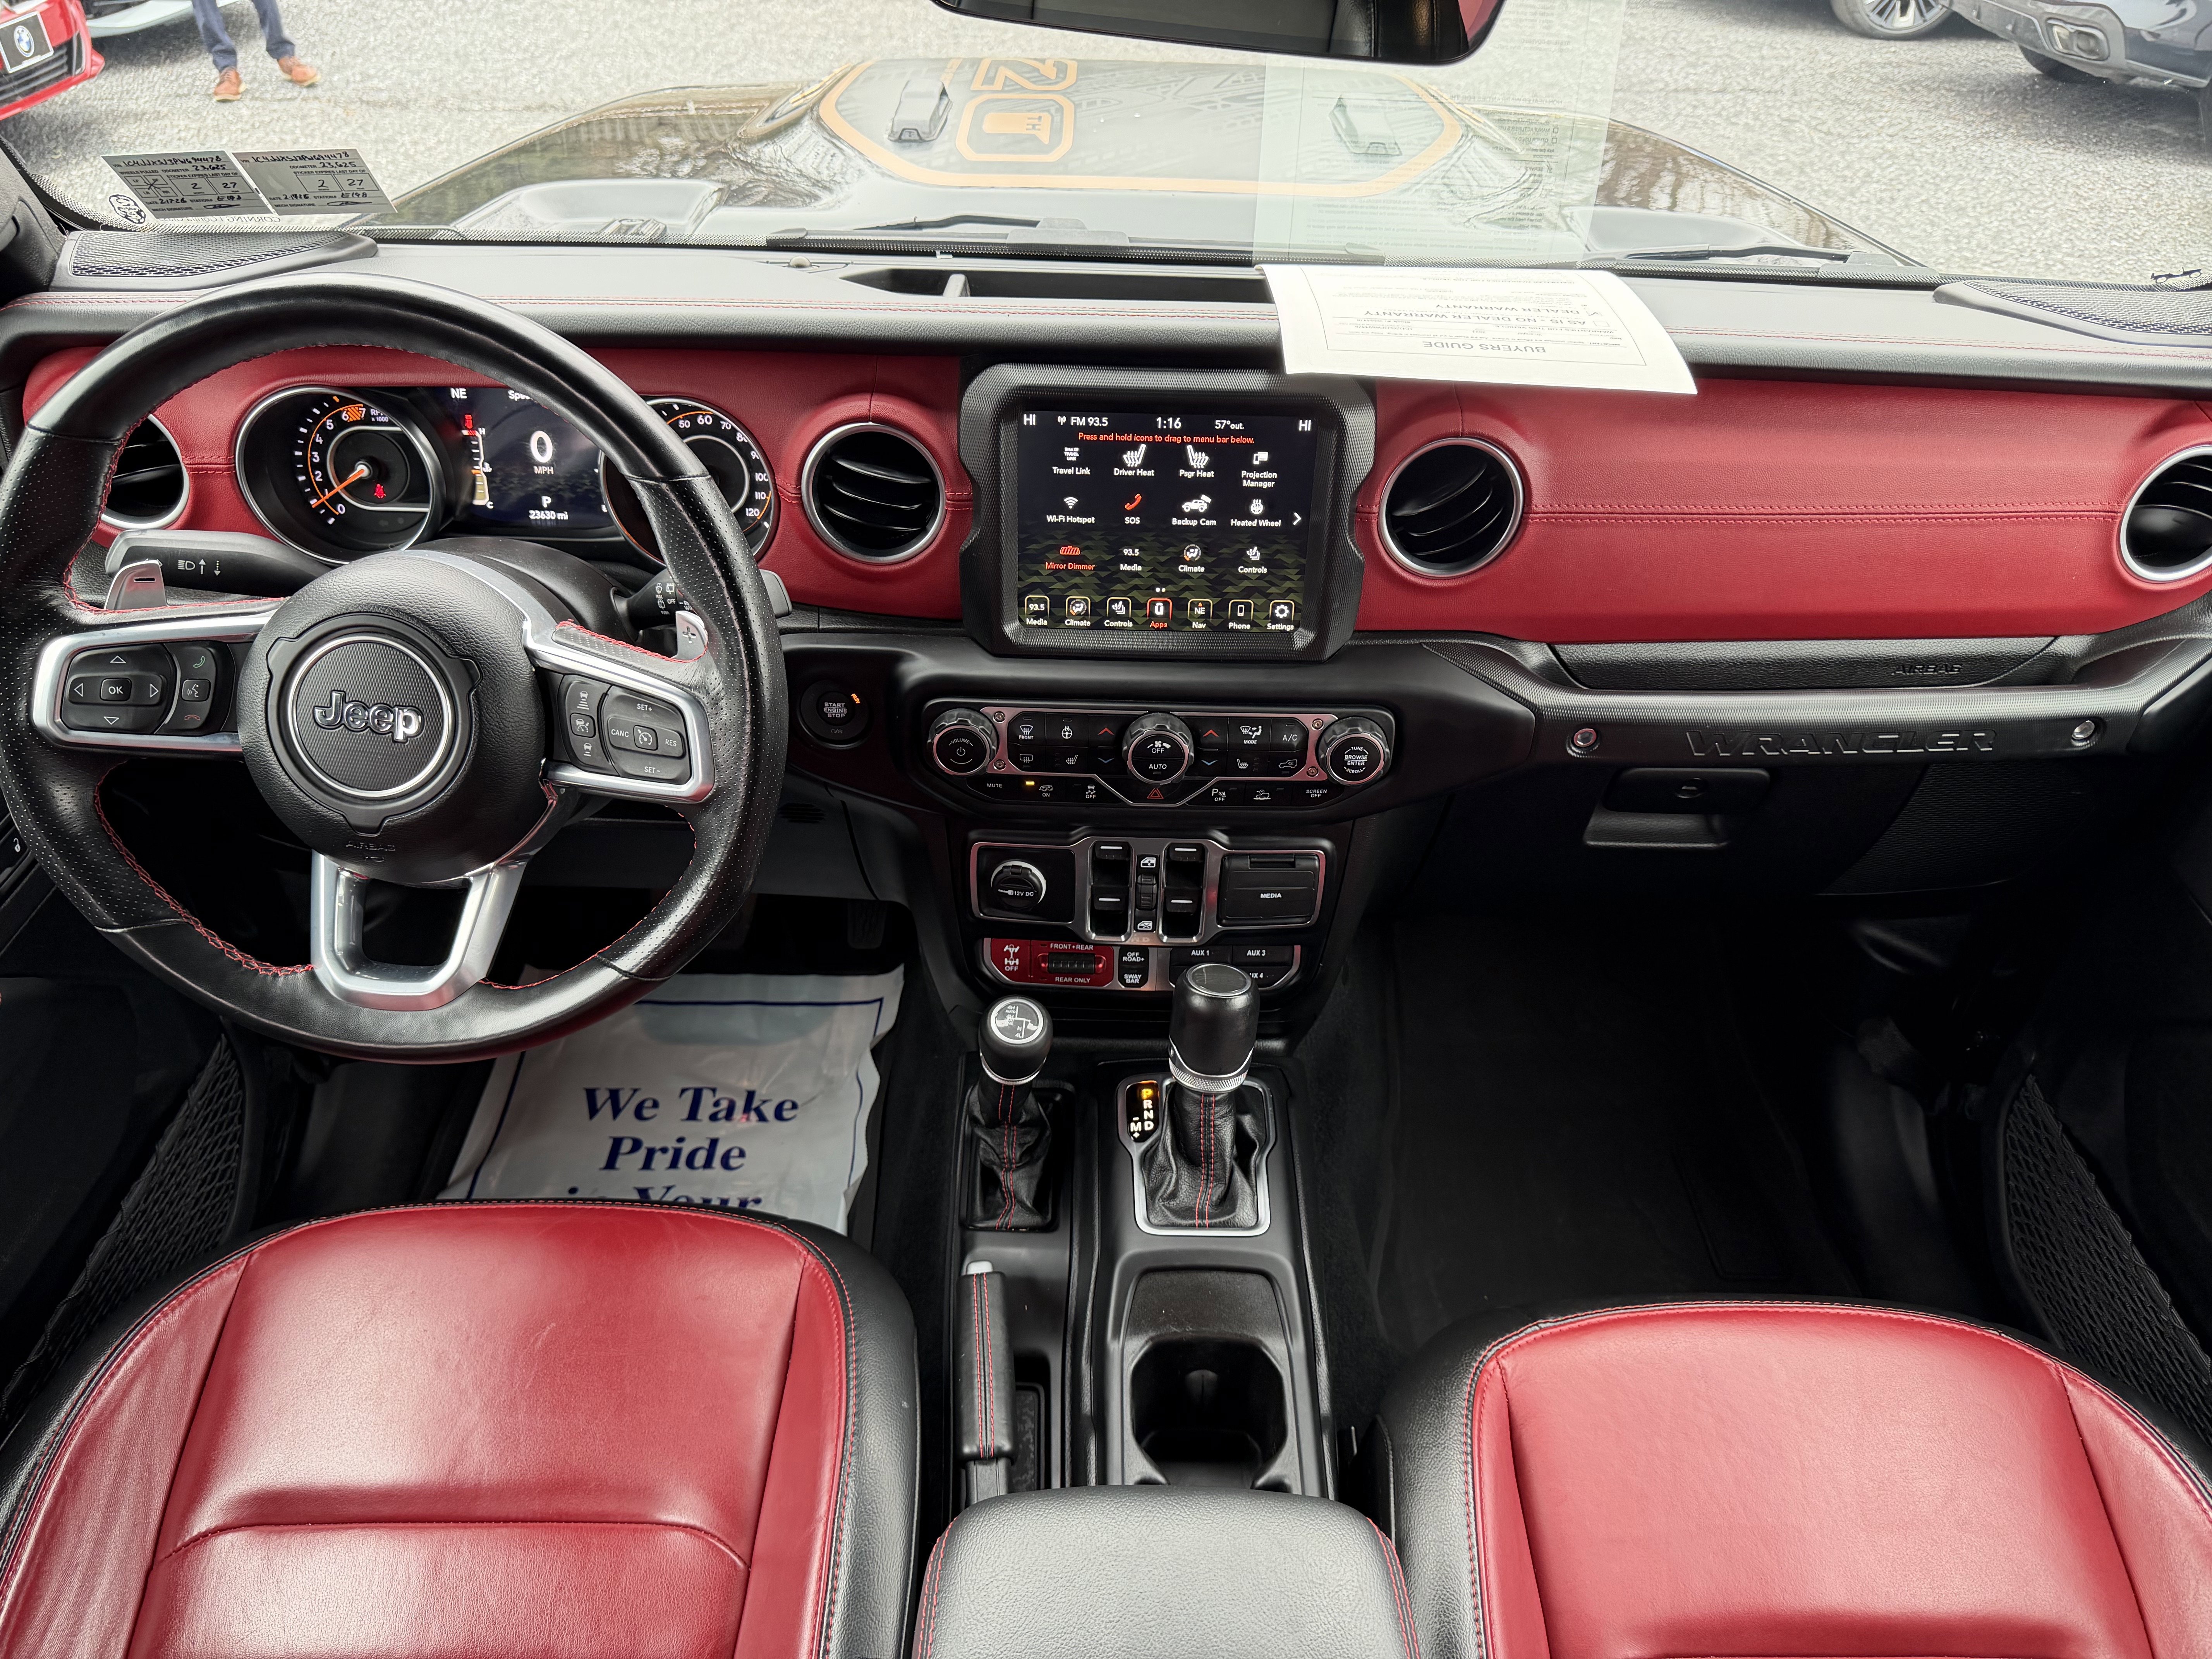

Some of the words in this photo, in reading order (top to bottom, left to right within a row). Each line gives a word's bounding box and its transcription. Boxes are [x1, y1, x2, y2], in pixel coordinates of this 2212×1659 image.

[1025, 115, 1043, 132] TH
[318, 179, 329, 188] 2
[1422, 341, 1474, 349] GUIDE
[1479, 343, 1546, 354] BUYERS
[450, 388, 467, 399] NE
[342, 410, 348, 421] 6
[360, 407, 366, 418] 7
[326, 419, 334, 430] 5
[678, 420, 691, 429] 50
[697, 415, 713, 425] 60
[720, 421, 732, 430] 70
[1024, 414, 1036, 426] HI
[1071, 417, 1085, 426] FM
[1087, 417, 1108, 426] 93.5
[1156, 417, 1182, 429] 1:16
[1299, 419, 1311, 431] HI
[315, 434, 323, 445] 4
[1079, 432, 1097, 440] Press
[1134, 434, 1153, 442] icons
[1164, 434, 1181, 443] drag
[1231, 436, 1255, 444] below.
[530, 431, 553, 463] 0
[312, 452, 319, 463] 3
[533, 465, 554, 475] MPH
[1052, 466, 1074, 474] Travel
[1114, 468, 1135, 476] Driver
[1179, 469, 1195, 478] Psgr
[1241, 471, 1277, 479] Projection
[314, 471, 323, 482] 2
[755, 472, 769, 482] 100
[1243, 480, 1275, 488] Manager
[755, 491, 766, 500] 110
[541, 496, 551, 508] P
[337, 503, 345, 515] 0
[745, 507, 760, 517] 120
[529, 510, 556, 520] 23630
[556, 511, 568, 520] mi
[1066, 515, 1095, 524] Hotspot
[1172, 518, 1198, 526] Backup
[1891, 664, 1963, 676] AIRBAG
[108, 685, 124, 695] OK
[851, 693, 860, 704] RUN
[314, 689, 425, 743] Jeep
[611, 728, 629, 738] CANC
[665, 738, 677, 747] RES
[1686, 729, 1999, 756] WRANGLER
[346, 840, 396, 852] AIRBAG
[1142, 1088, 1153, 1099] P
[582, 1086, 660, 1122] We
[678, 1086, 799, 1123] Take
[1143, 1099, 1153, 1109] R
[1144, 1110, 1154, 1120] N
[1130, 1121, 1142, 1132] M
[1144, 1121, 1154, 1131] D
[599, 1135, 747, 1171] Pride
